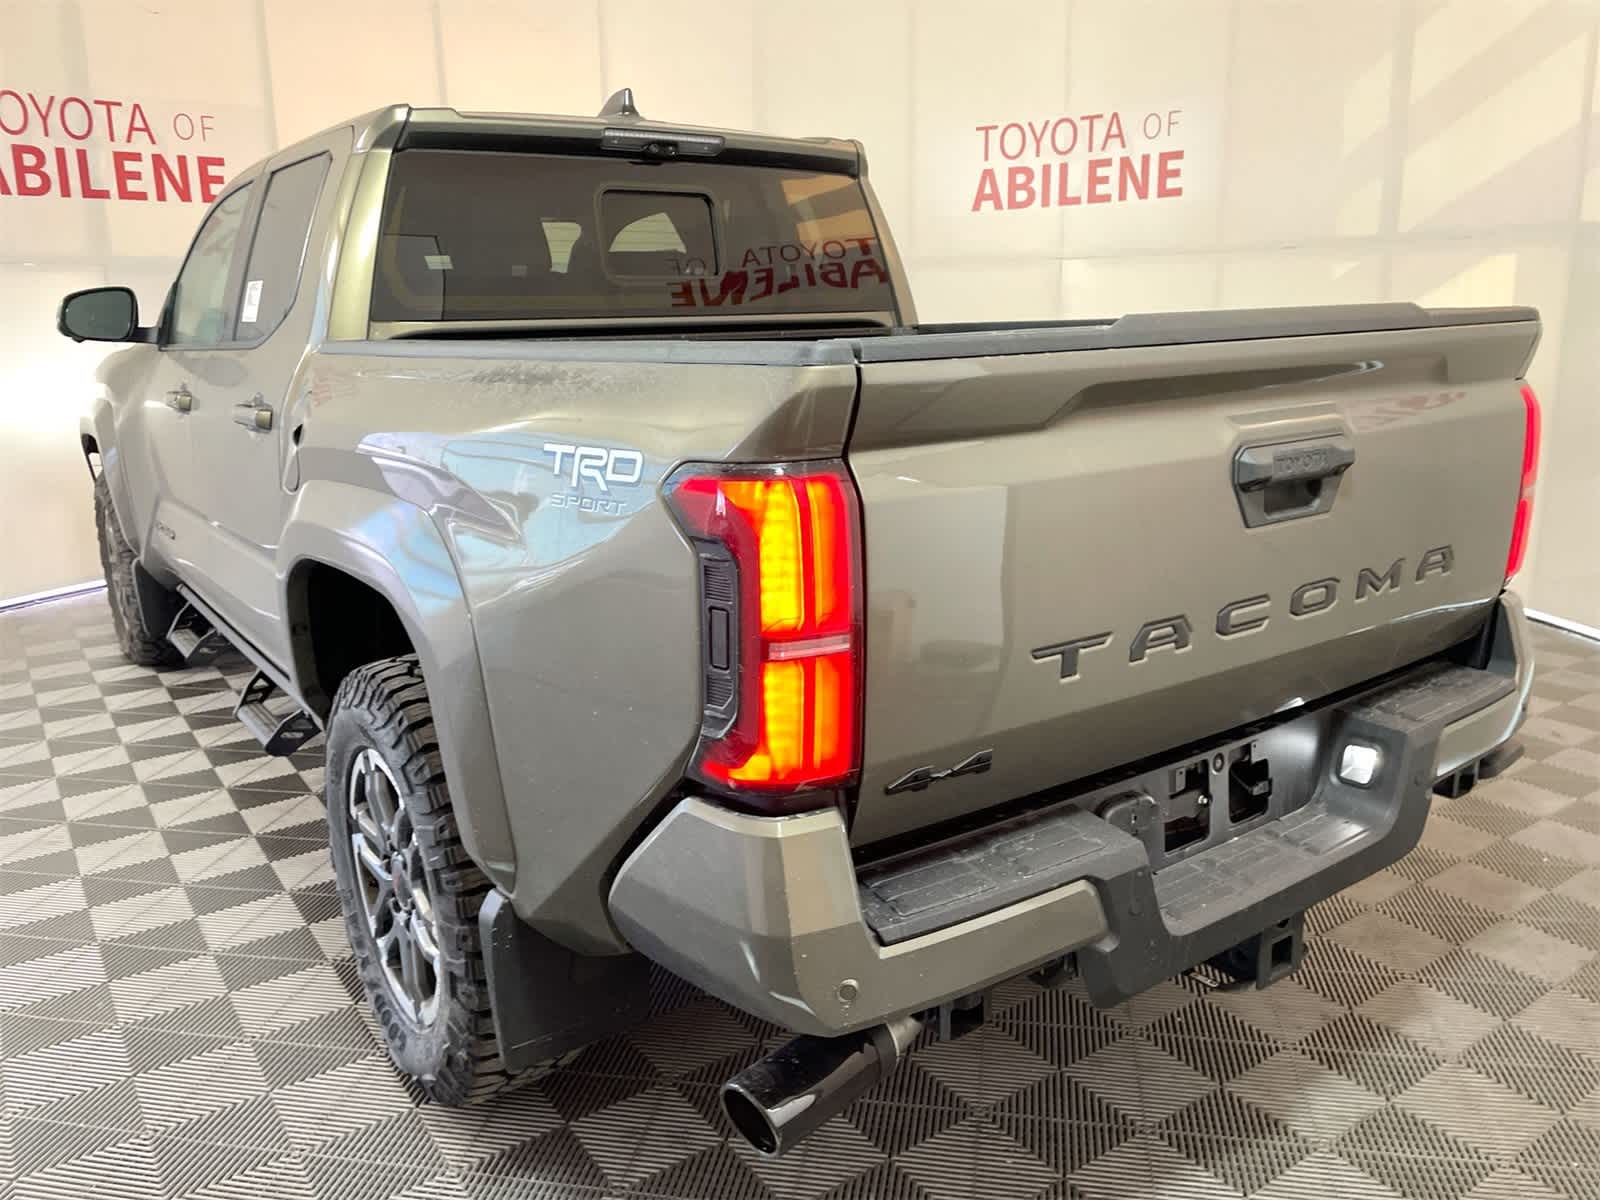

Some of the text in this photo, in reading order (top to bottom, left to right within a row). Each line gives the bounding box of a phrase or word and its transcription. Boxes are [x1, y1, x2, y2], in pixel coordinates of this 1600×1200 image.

[173, 113, 215, 141] OF
[975, 110, 1183, 162] TOYOTA OF
[971, 150, 1185, 212] ABILENE
[543, 442, 643, 491] TRD
[550, 494, 627, 516] SPORT
[1031, 544, 1455, 681] TACOMA
